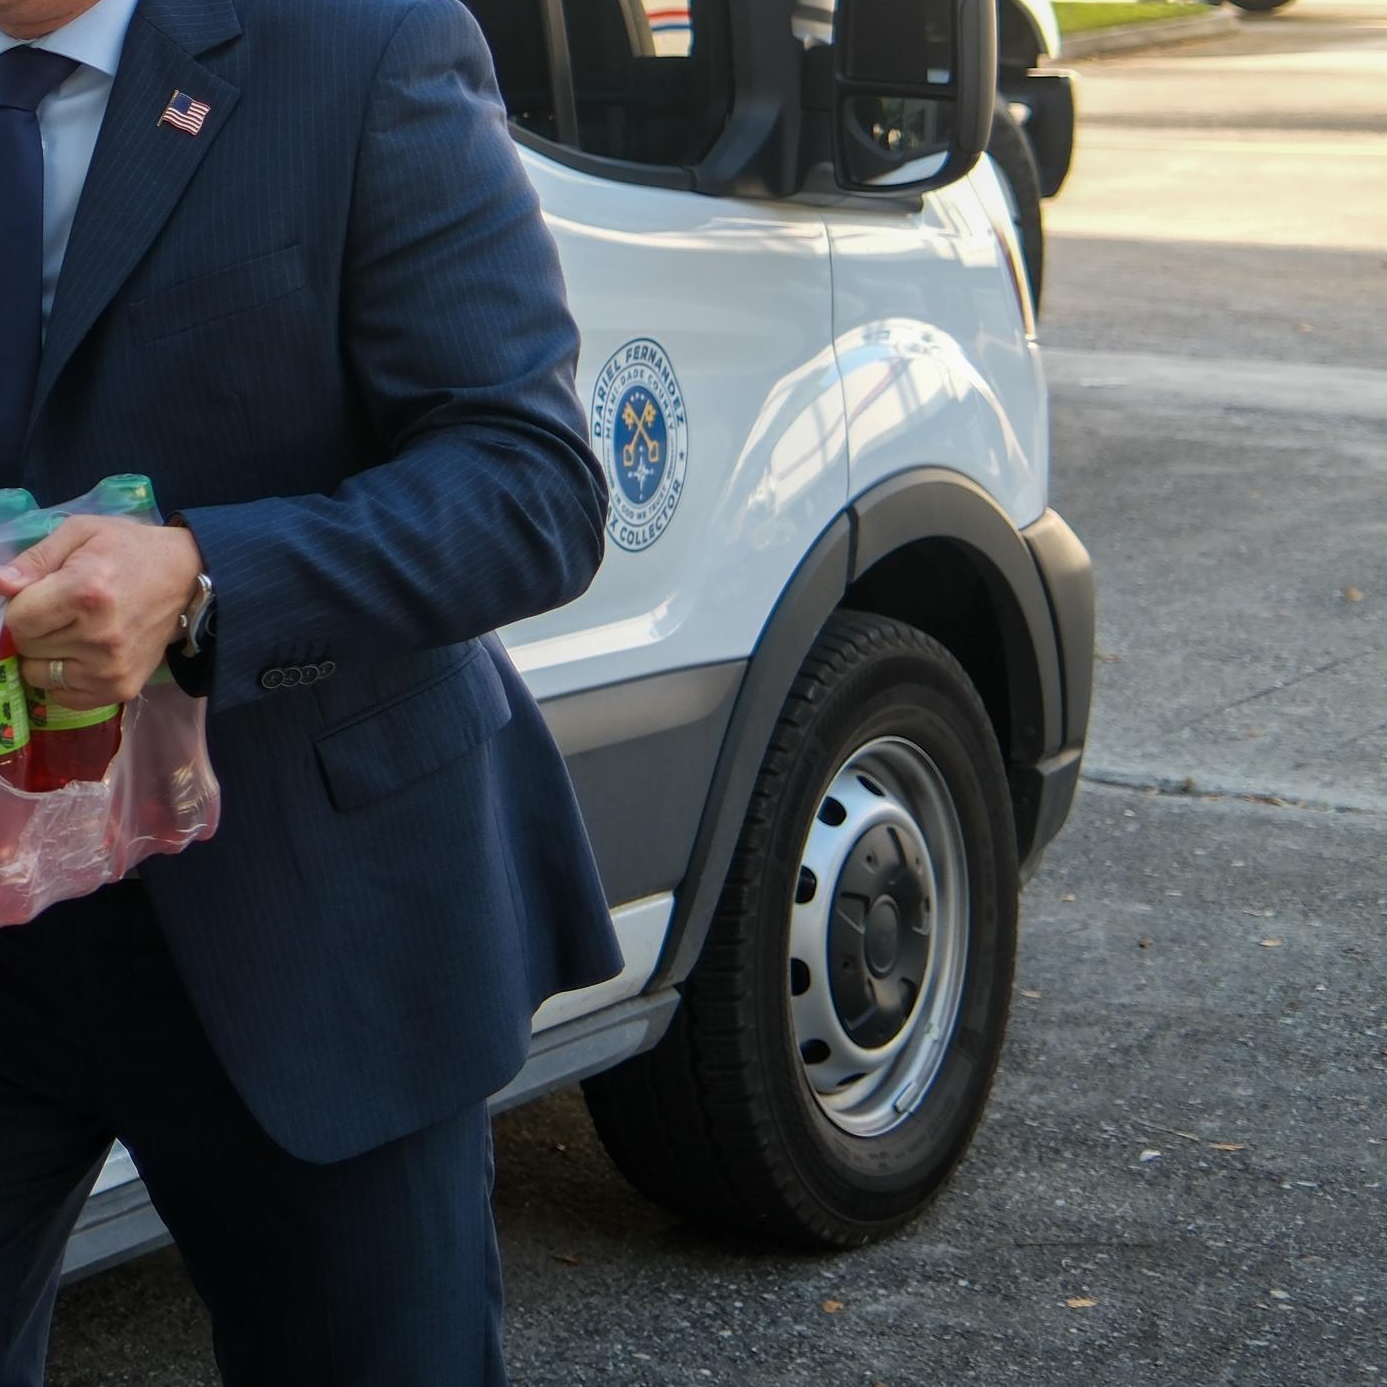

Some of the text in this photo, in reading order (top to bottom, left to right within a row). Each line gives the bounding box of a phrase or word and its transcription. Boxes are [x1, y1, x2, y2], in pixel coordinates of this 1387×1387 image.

[594, 344, 684, 438] DARIEL FERNANDEZ
[619, 479, 681, 546] COLLECTOR
